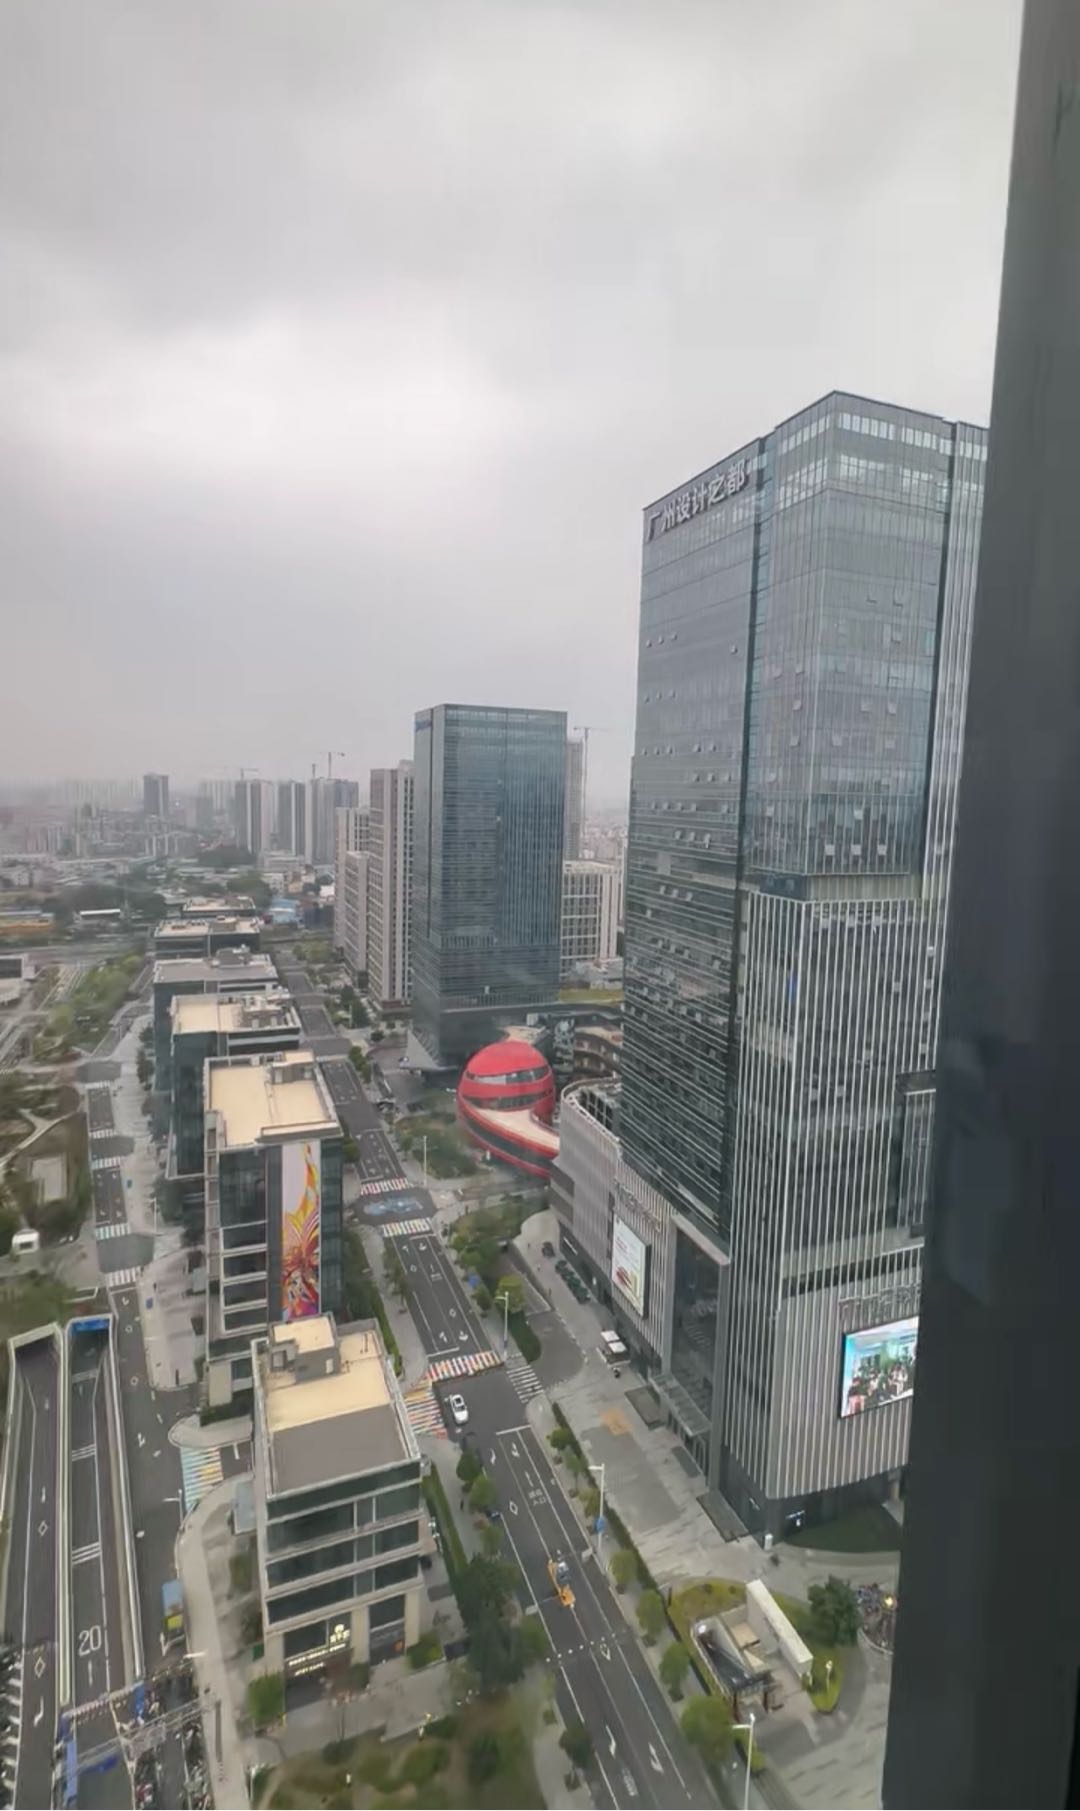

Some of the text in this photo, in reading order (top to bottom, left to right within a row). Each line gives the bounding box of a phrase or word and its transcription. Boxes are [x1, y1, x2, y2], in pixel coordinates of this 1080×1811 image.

[647, 459, 748, 544] 广州设计之都
[78, 1624, 102, 1657] 20
